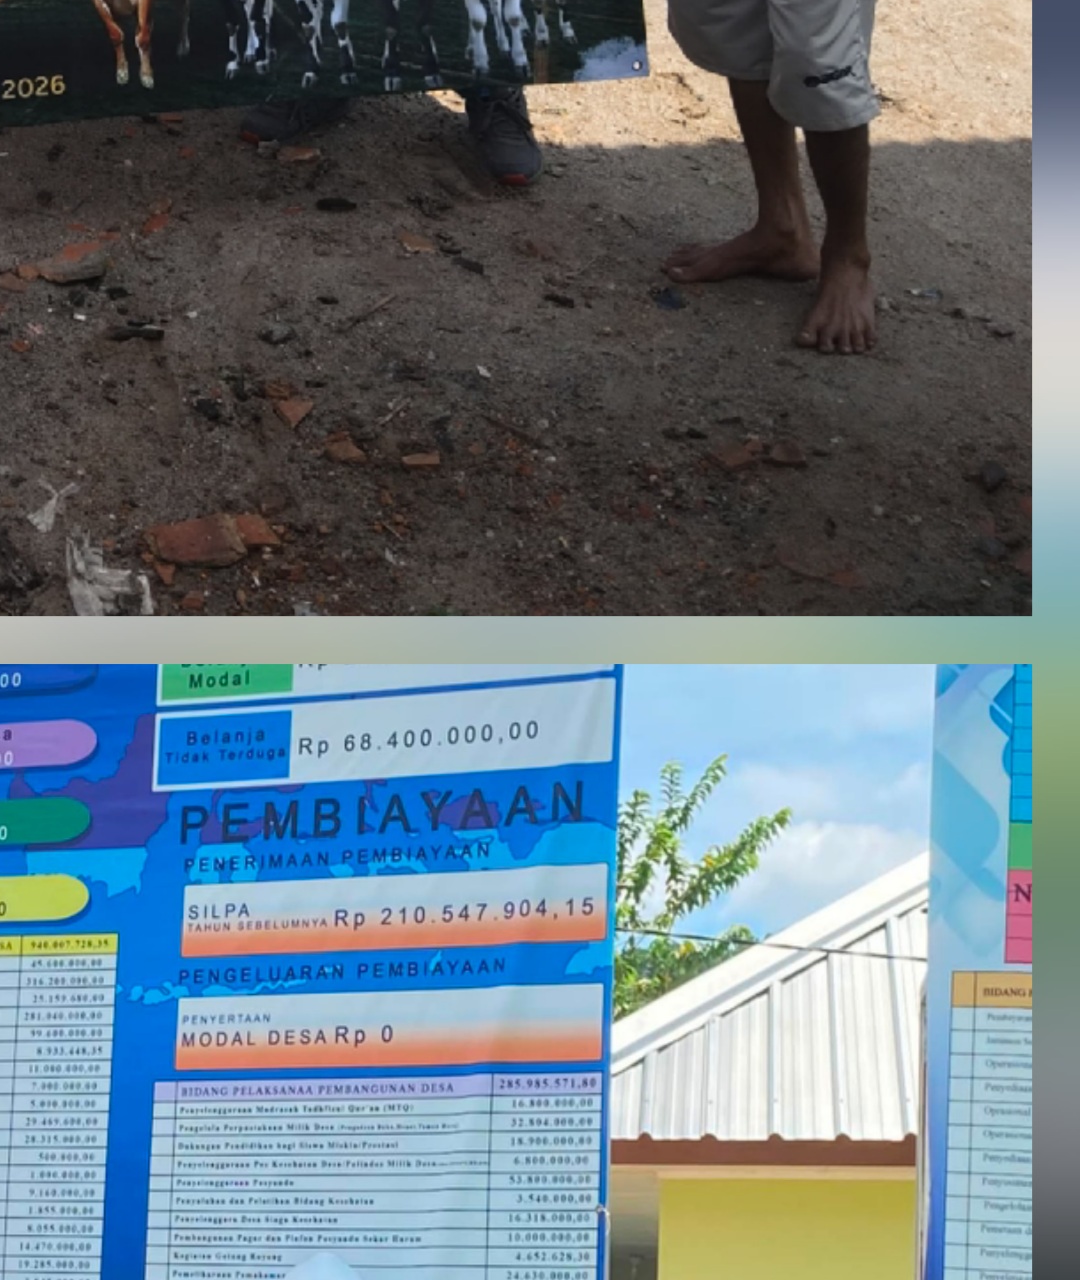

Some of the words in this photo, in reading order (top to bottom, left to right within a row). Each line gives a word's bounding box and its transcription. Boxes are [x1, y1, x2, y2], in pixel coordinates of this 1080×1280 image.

[2, 75, 66, 100] 2026
[188, 672, 251, 689] Modal
[186, 729, 266, 747] Belanja
[298, 738, 329, 759] Rp
[344, 720, 540, 752] 68.400.000,00
[165, 751, 212, 764] Tidak
[219, 747, 287, 762] Terduga
[180, 781, 584, 845] PEMBIAYAAN
[184, 851, 330, 873] PENERIMAAN
[342, 843, 490, 864] PEMBIAYAAN
[188, 903, 250, 920] SILPA
[334, 910, 366, 931] Rp
[380, 897, 595, 926] 210.547.904,15
[188, 922, 231, 933] TAHUN
[237, 917, 329, 931] SEBELUMNYA
[178, 964, 345, 985] PENGELUARAN
[357, 957, 506, 978] PEMBIAYAAN
[182, 1014, 271, 1025] PENYERTAAN
[181, 1031, 256, 1048] MODAL
[268, 1029, 327, 1046] DESA
[335, 1026, 366, 1047] Rp
[381, 1025, 394, 1043] 0
[181, 1086, 228, 1097] BIDANG
[233, 1085, 314, 1096] PELAKSANAA
[318, 1084, 416, 1095] PEMBANGUNAN
[421, 1085, 454, 1093] DESA
